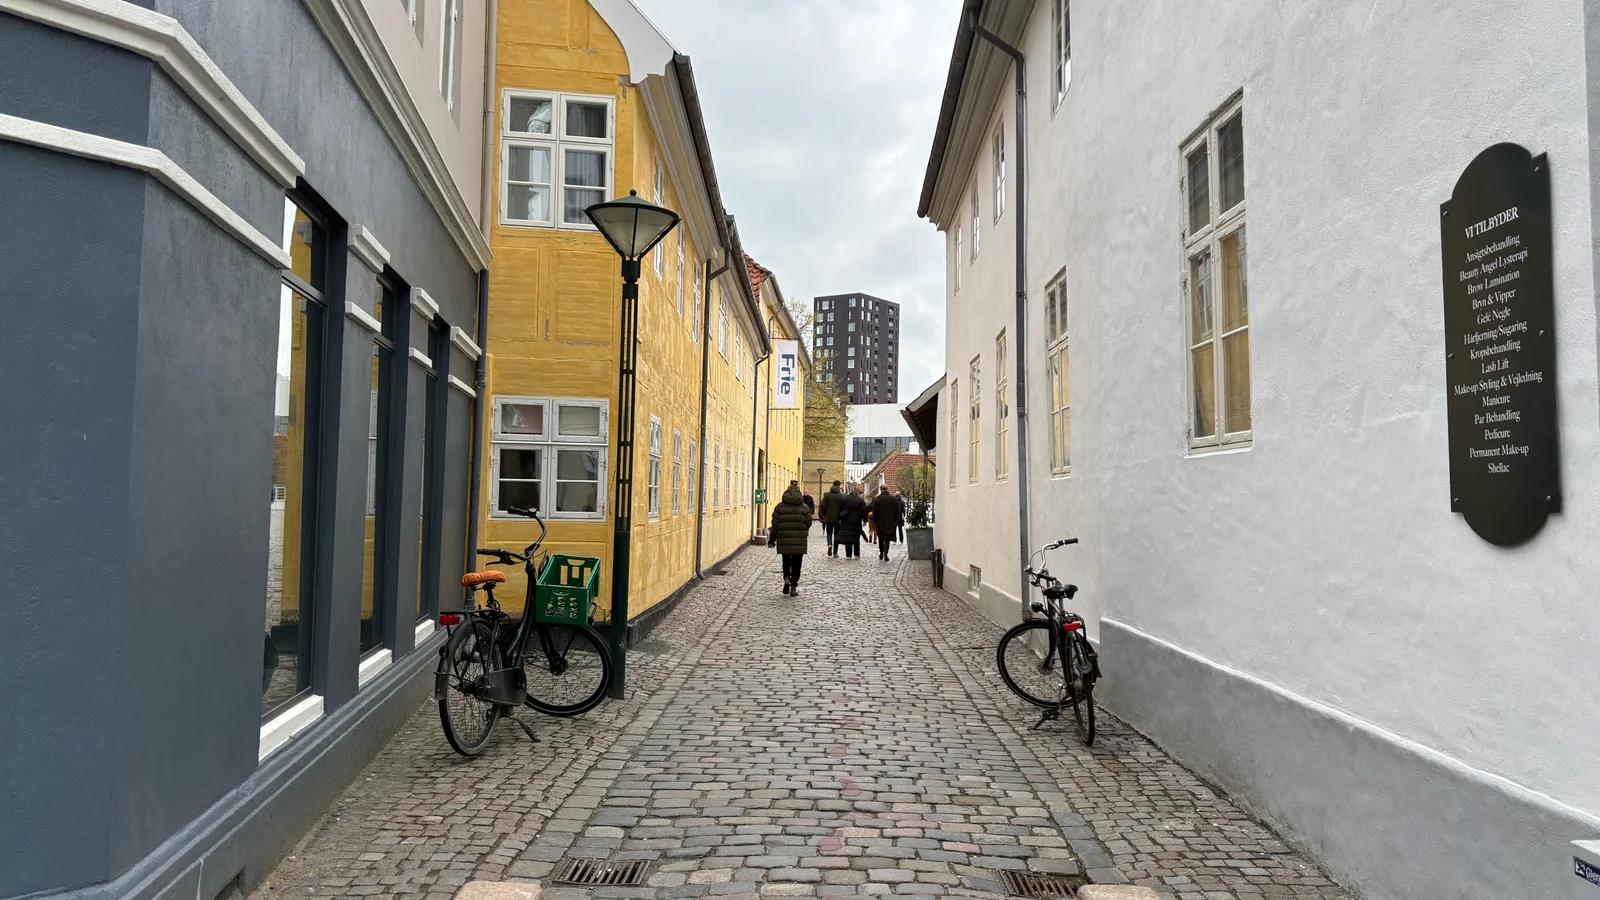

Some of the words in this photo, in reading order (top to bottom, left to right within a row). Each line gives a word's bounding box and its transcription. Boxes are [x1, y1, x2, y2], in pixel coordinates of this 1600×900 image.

[1464, 226, 1474, 239] VI
[1474, 206, 1519, 236] TILBYDER
[1465, 234, 1520, 263] Ansigtsbehandling
[1459, 265, 1479, 281] Beauty
[1480, 258, 1498, 274] Angel
[1499, 247, 1528, 268] Lysterapi
[1467, 282, 1484, 295] Brow
[1484, 269, 1520, 290] Lamination
[1472, 298, 1487, 310] Bryn
[1487, 294, 1494, 305] &
[1494, 289, 1516, 303] Vipper
[1492, 306, 1511, 321] Negle
[1470, 339, 1521, 360] Kropsbehandling
[781, 353, 796, 395] Frie
[1481, 361, 1497, 374] Lash
[1497, 358, 1509, 371] Lift
[1454, 383, 1479, 396] Make-up
[1479, 379, 1500, 393] Styling
[1500, 376, 1507, 387] &
[1508, 370, 1543, 388] Vejledning
[1482, 395, 1511, 407] Manicure
[1474, 414, 1485, 425] Par
[1485, 410, 1521, 424] Behandling
[1484, 428, 1511, 440] Pedicure
[1469, 447, 1501, 458] Permanent
[1501, 444, 1530, 456] Make-up
[1488, 462, 1510, 474] Shellac
